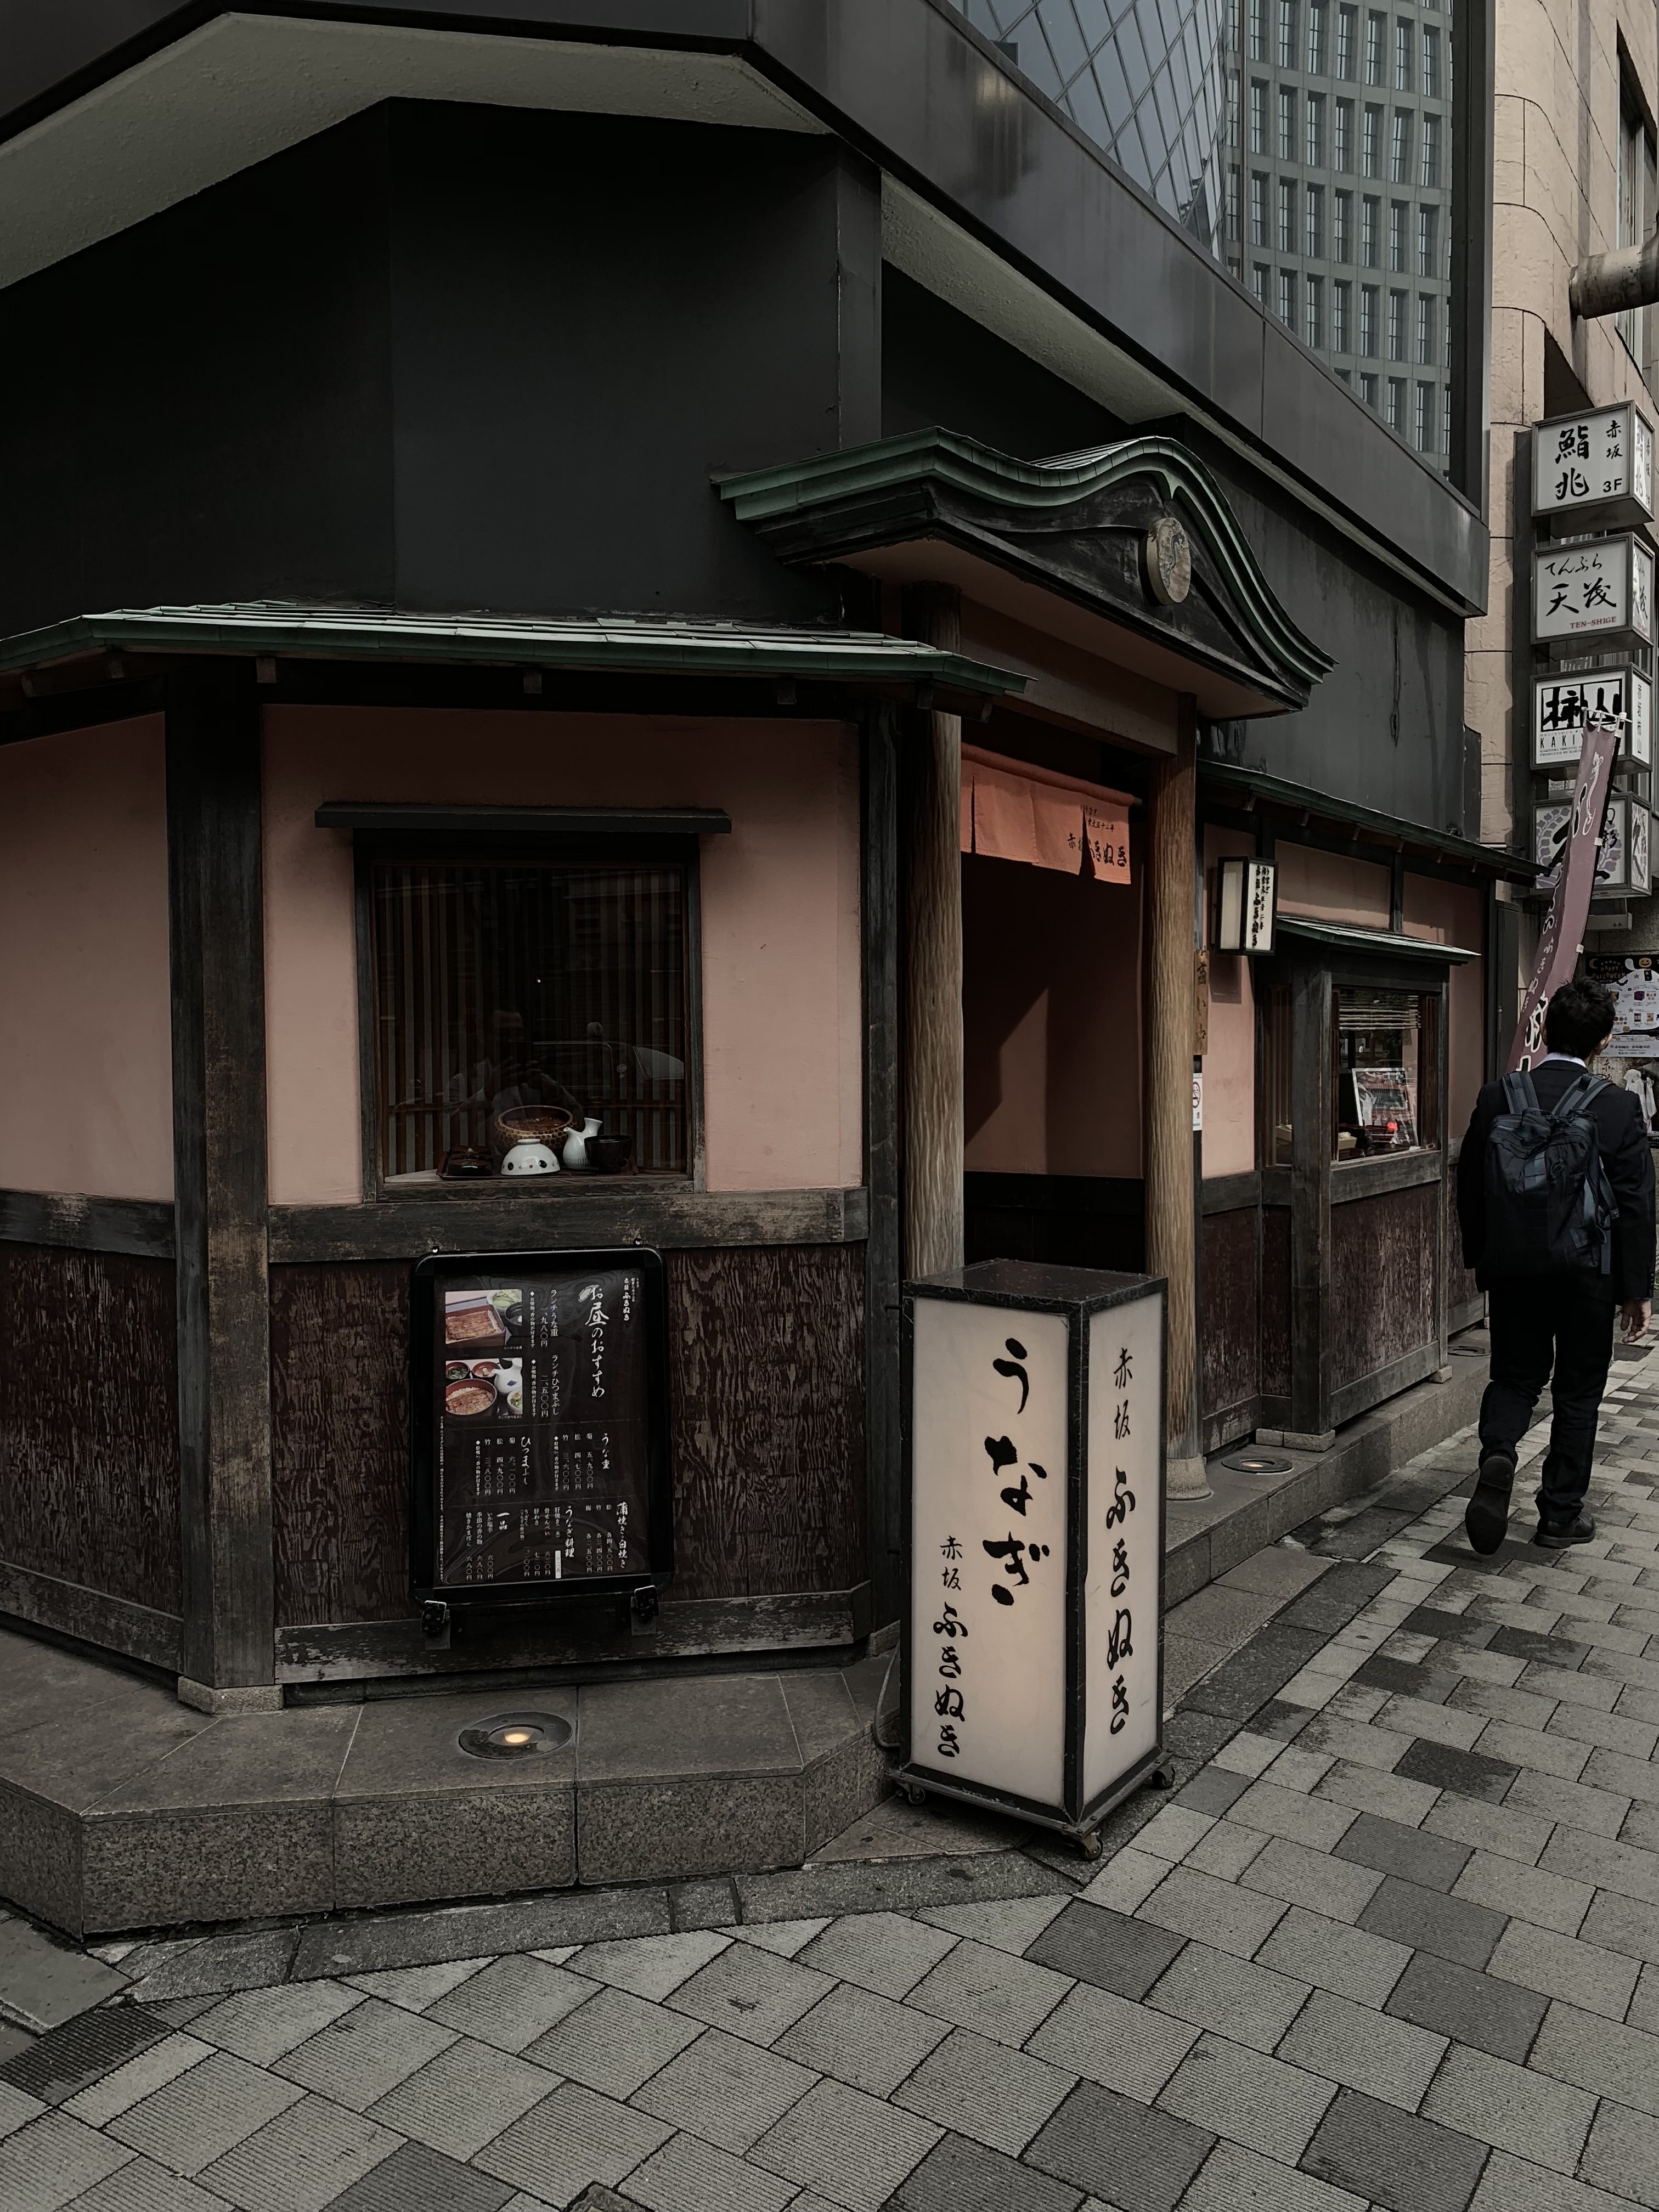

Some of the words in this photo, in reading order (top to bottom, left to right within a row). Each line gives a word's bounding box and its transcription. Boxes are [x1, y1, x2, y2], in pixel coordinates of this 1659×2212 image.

[1555, 425, 1589, 500] 鮨兆
[1606, 420, 1623, 459] 赤坂
[1603, 478, 1622, 493] 3F
[1545, 553, 1602, 576] てんぷら
[1570, 616, 1617, 629] TEN-SHIGE
[1592, 972, 1625, 980] HALLOWEEN
[550, 1289, 559, 1338] ランチうな重
[578, 1284, 610, 1398] お昼のおすすめ
[551, 1354, 560, 1417] ランチひつまぶし
[521, 1436, 532, 1485] ひつまぶし
[601, 1432, 610, 1470] うな重
[982, 1337, 1049, 1606] うなぎ
[496, 1512, 510, 1531] 一品
[565, 1505, 575, 1558] うなぎ料理
[1106, 1347, 1136, 1735] 赤坂ふきぬき
[933, 1535, 968, 1757] 赤坂ふきぬき
